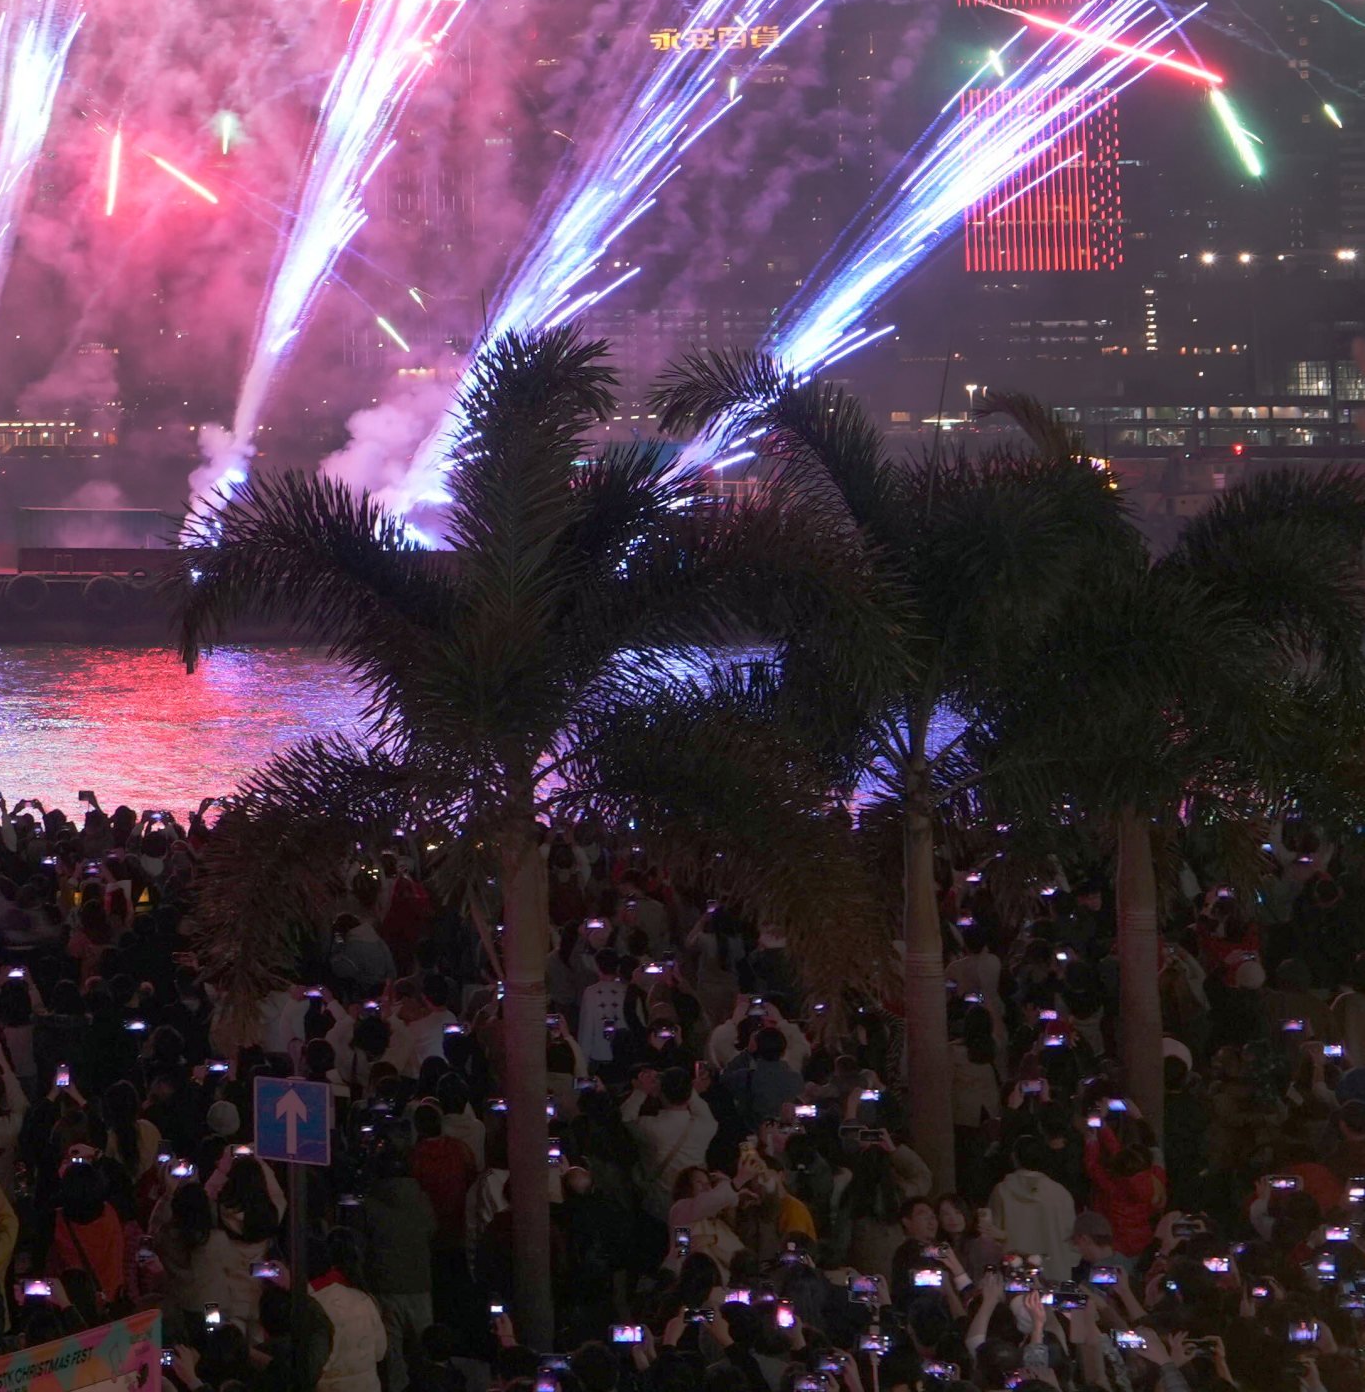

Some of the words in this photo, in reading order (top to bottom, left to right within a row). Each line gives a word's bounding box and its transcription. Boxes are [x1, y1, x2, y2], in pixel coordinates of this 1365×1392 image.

[649, 25, 780, 51] 永安百貨
[14, 1352, 70, 1384] CHRISTMAS
[70, 1345, 94, 1367] FEST
